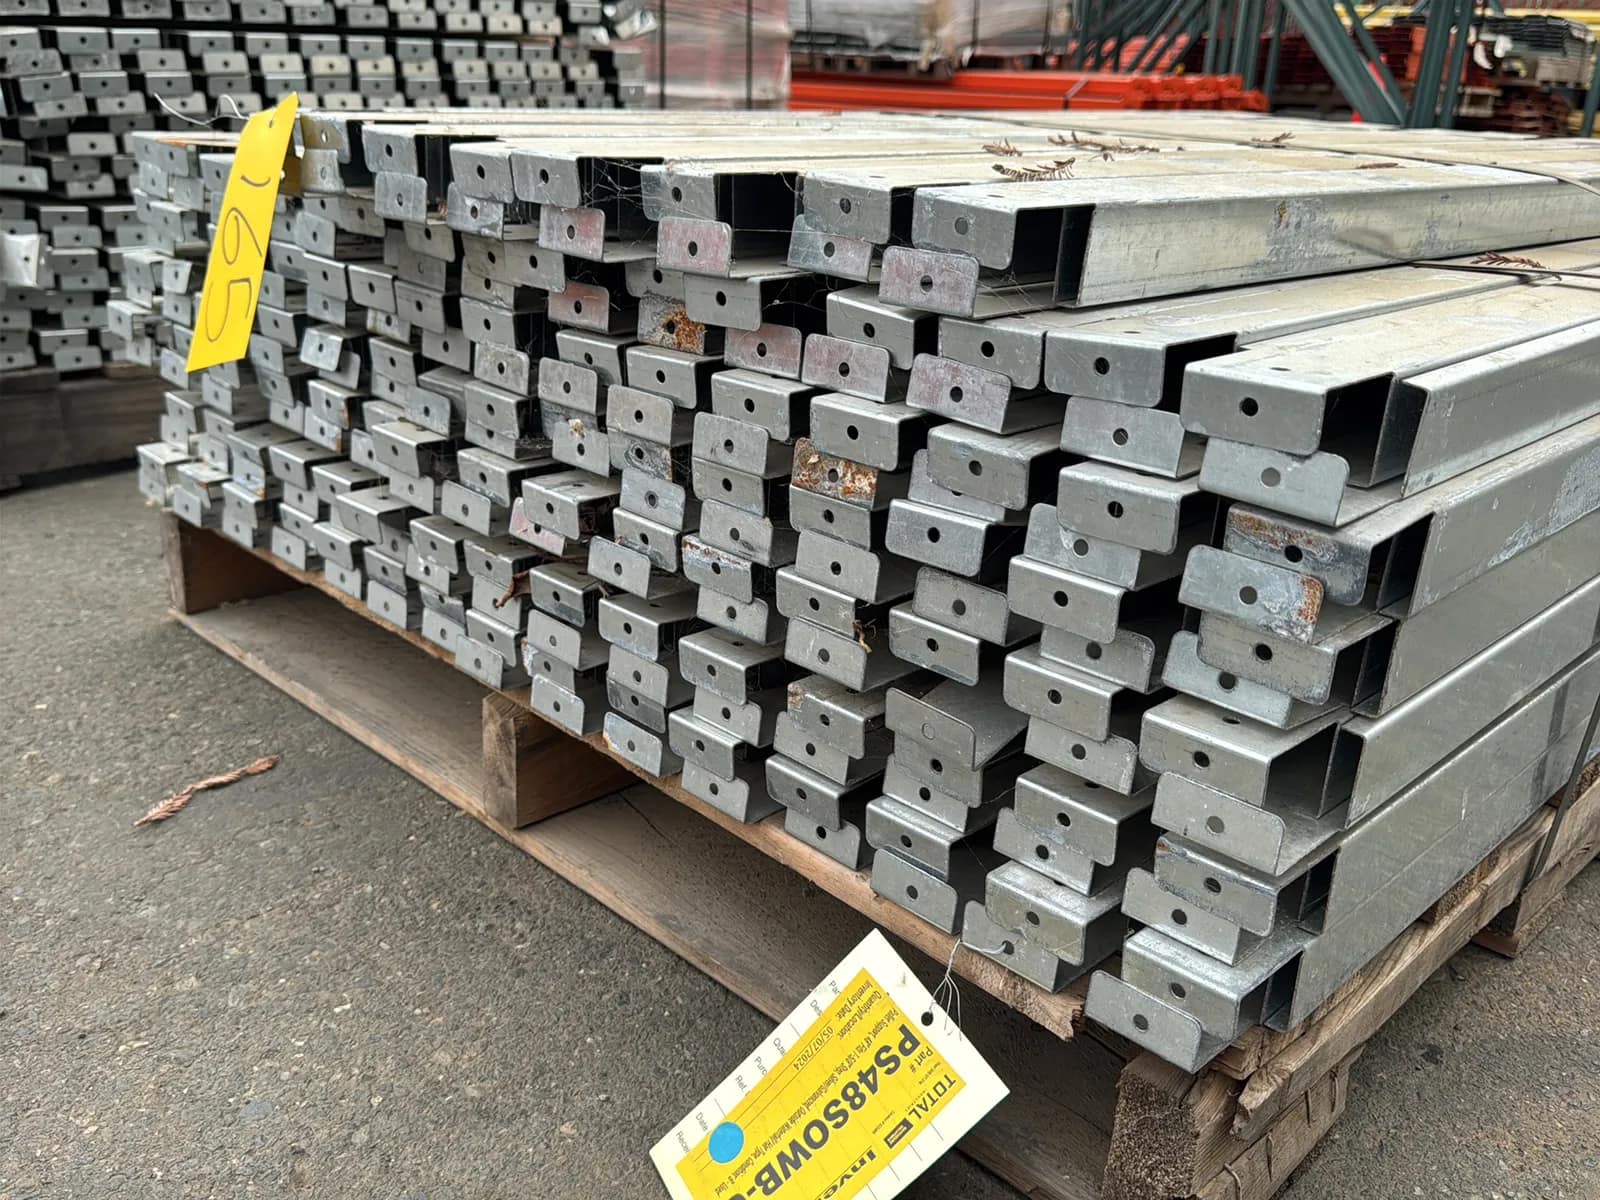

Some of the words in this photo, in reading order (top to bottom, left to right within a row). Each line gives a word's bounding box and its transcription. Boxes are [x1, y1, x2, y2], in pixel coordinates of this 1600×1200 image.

[846, 980, 873, 1007] Inventory
[834, 1003, 852, 1020] Date:
[837, 990, 881, 1039] Quantity/Location:
[883, 1007, 899, 1023] Pallet
[791, 1026, 833, 1070] 05/07/2024
[914, 1046, 933, 1066] Part
[909, 1063, 916, 1073] #
[908, 1074, 956, 1119] TOTAL
[788, 1106, 806, 1124] Outside
[817, 1148, 875, 1200] Inve
[714, 1181, 728, 1197] Used
